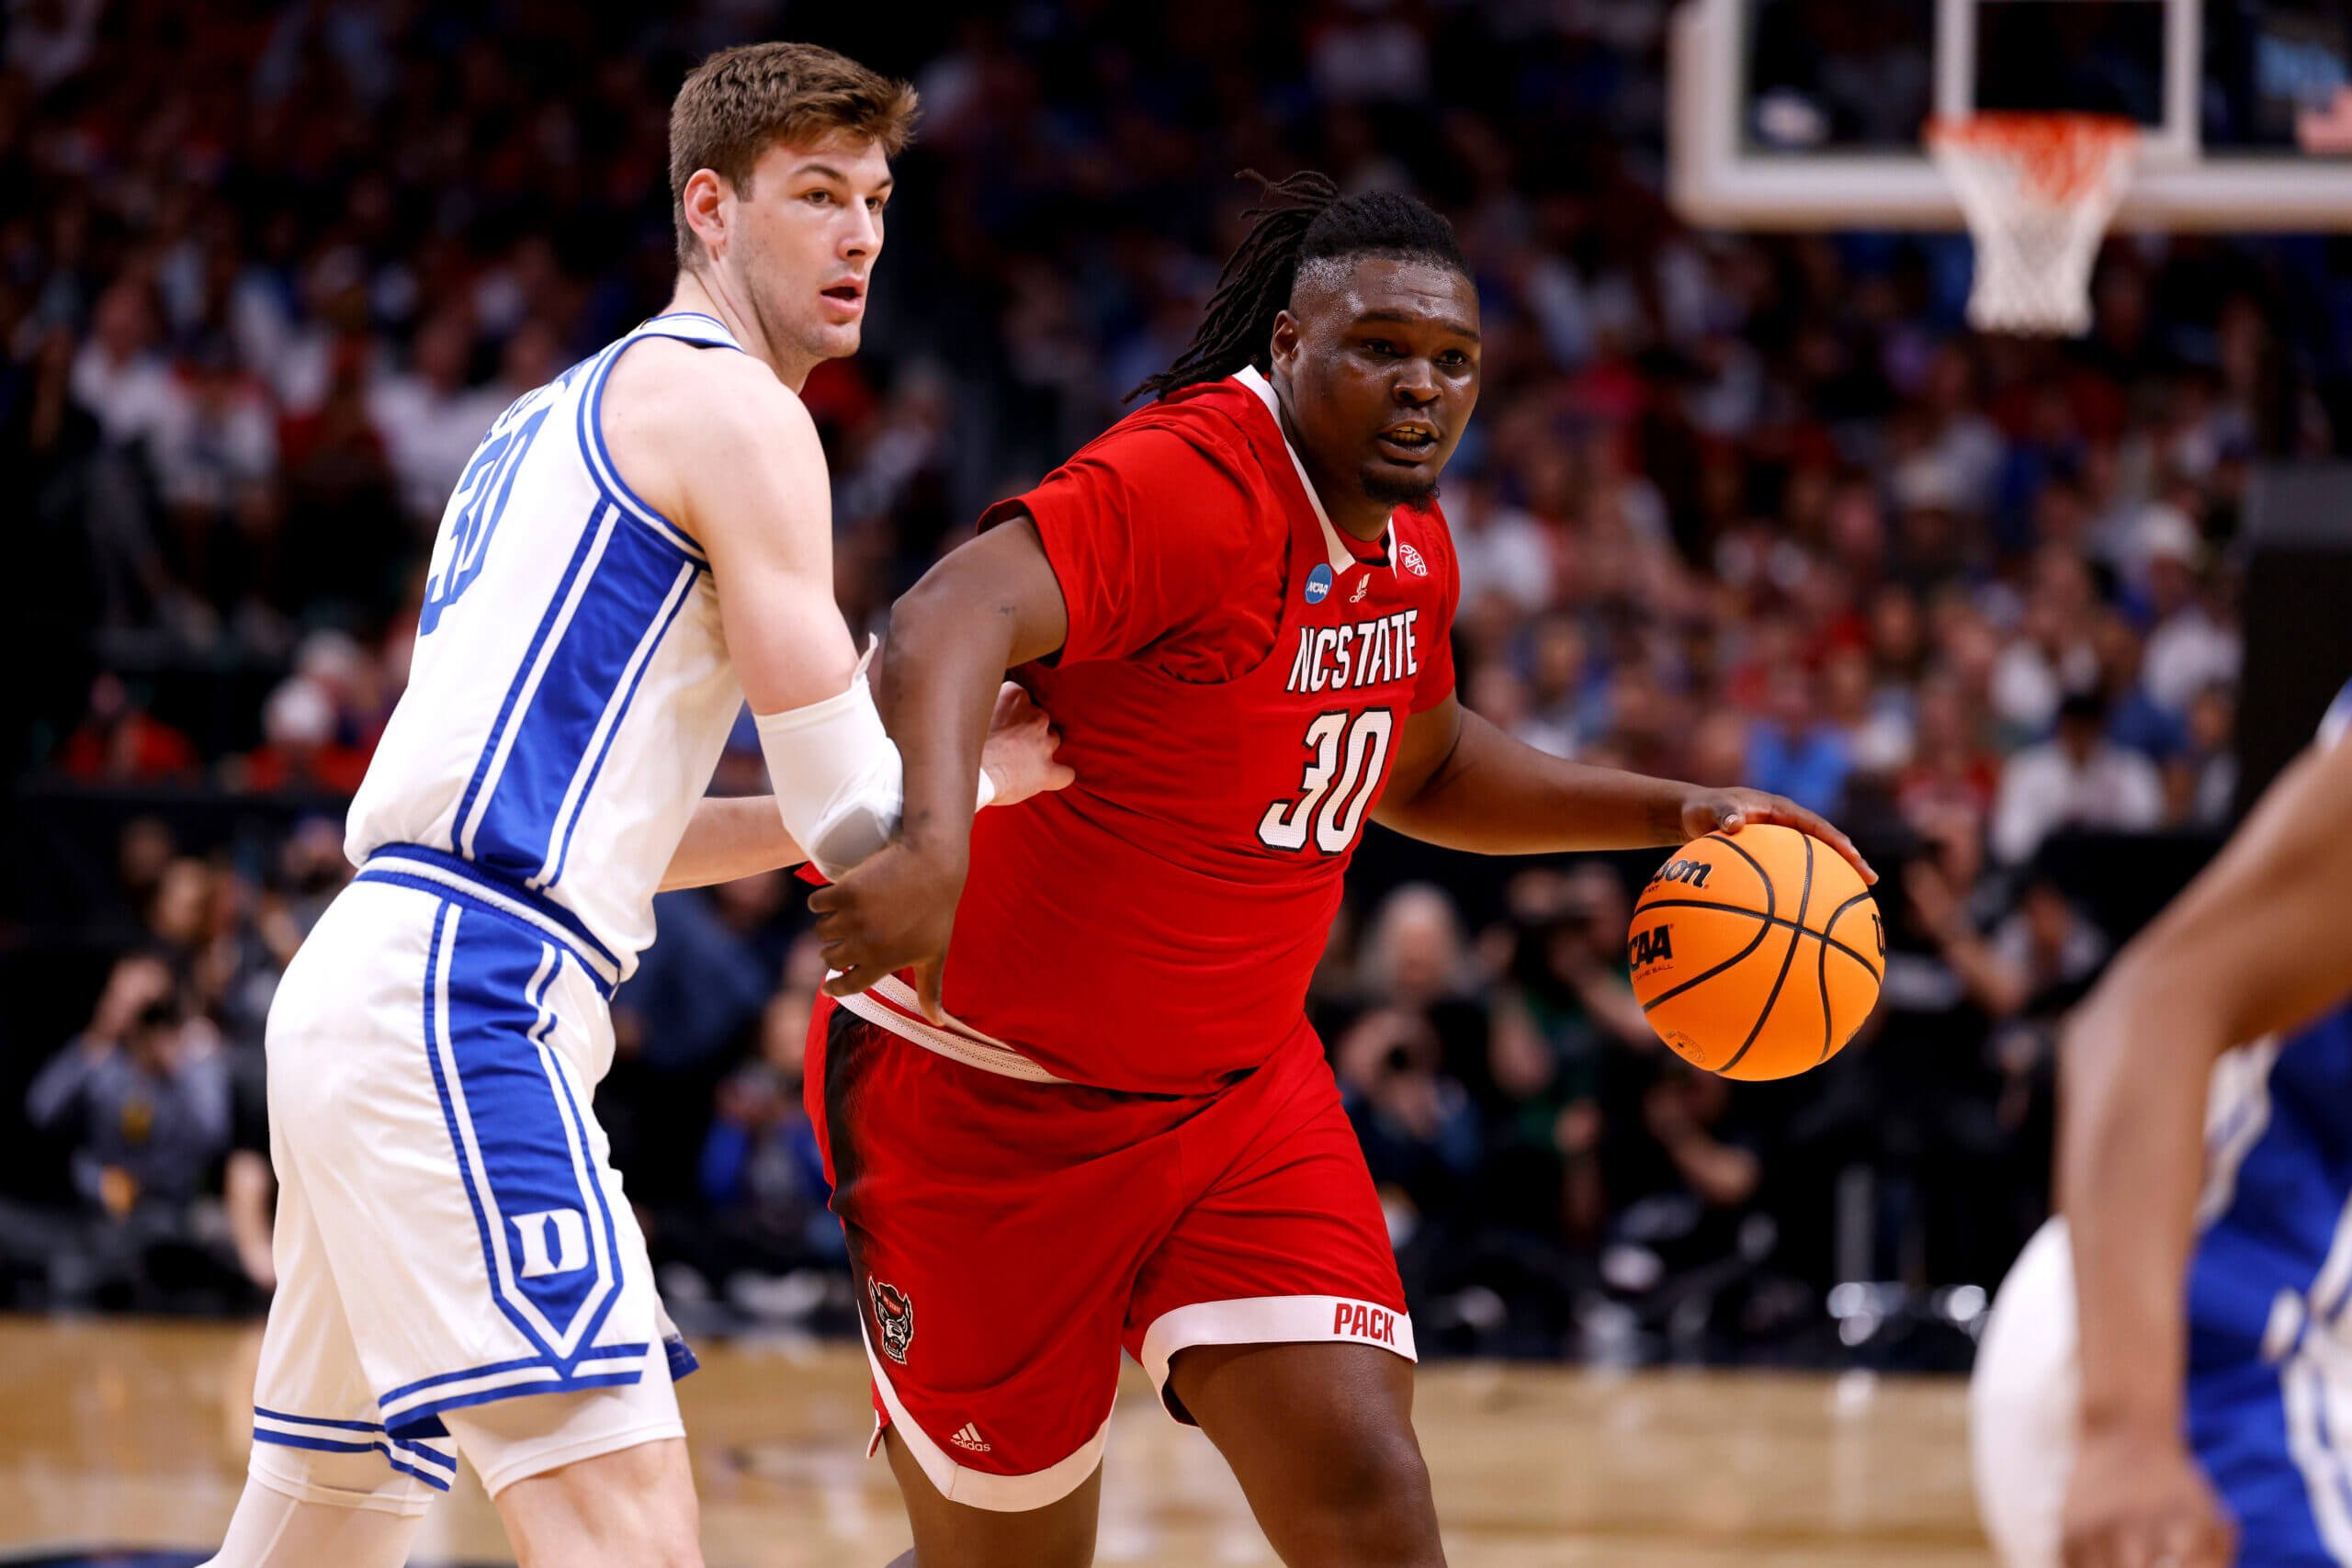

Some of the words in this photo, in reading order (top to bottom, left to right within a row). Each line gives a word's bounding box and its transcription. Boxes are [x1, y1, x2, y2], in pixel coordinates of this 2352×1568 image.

[419, 403, 554, 637] 30
[1405, 553, 1420, 567] ACC
[1306, 581, 1329, 595] NCAA
[1255, 706, 1393, 856] 30
[509, 1208, 589, 1279] D
[1333, 1303, 1395, 1346] PACK
[951, 1438, 991, 1451] adidas
